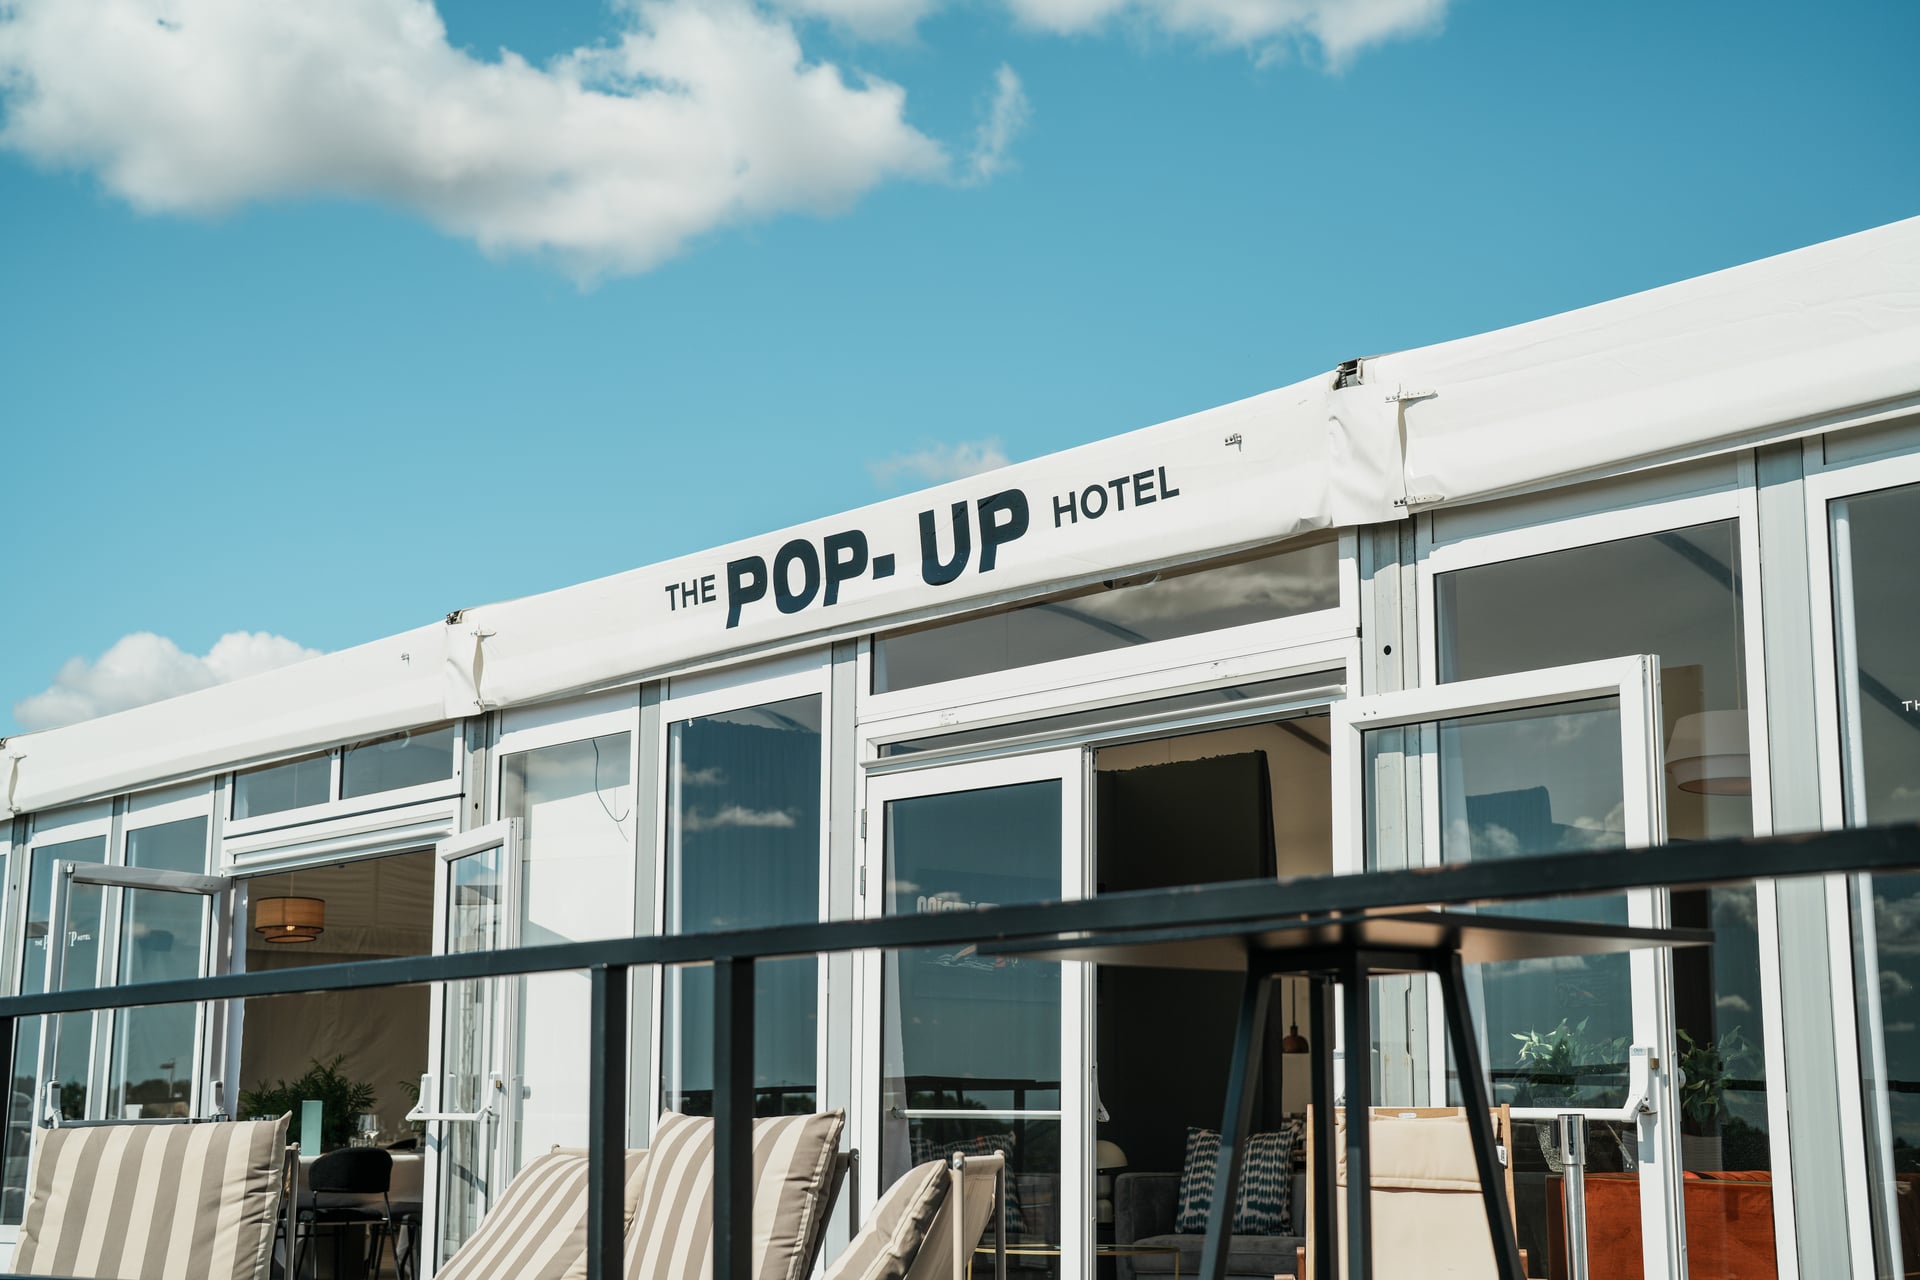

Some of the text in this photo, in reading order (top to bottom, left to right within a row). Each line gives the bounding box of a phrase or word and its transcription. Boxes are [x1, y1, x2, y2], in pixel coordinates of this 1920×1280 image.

[666, 574, 717, 611] THE
[919, 488, 1030, 587] UP
[1053, 466, 1180, 528] HOTEL
